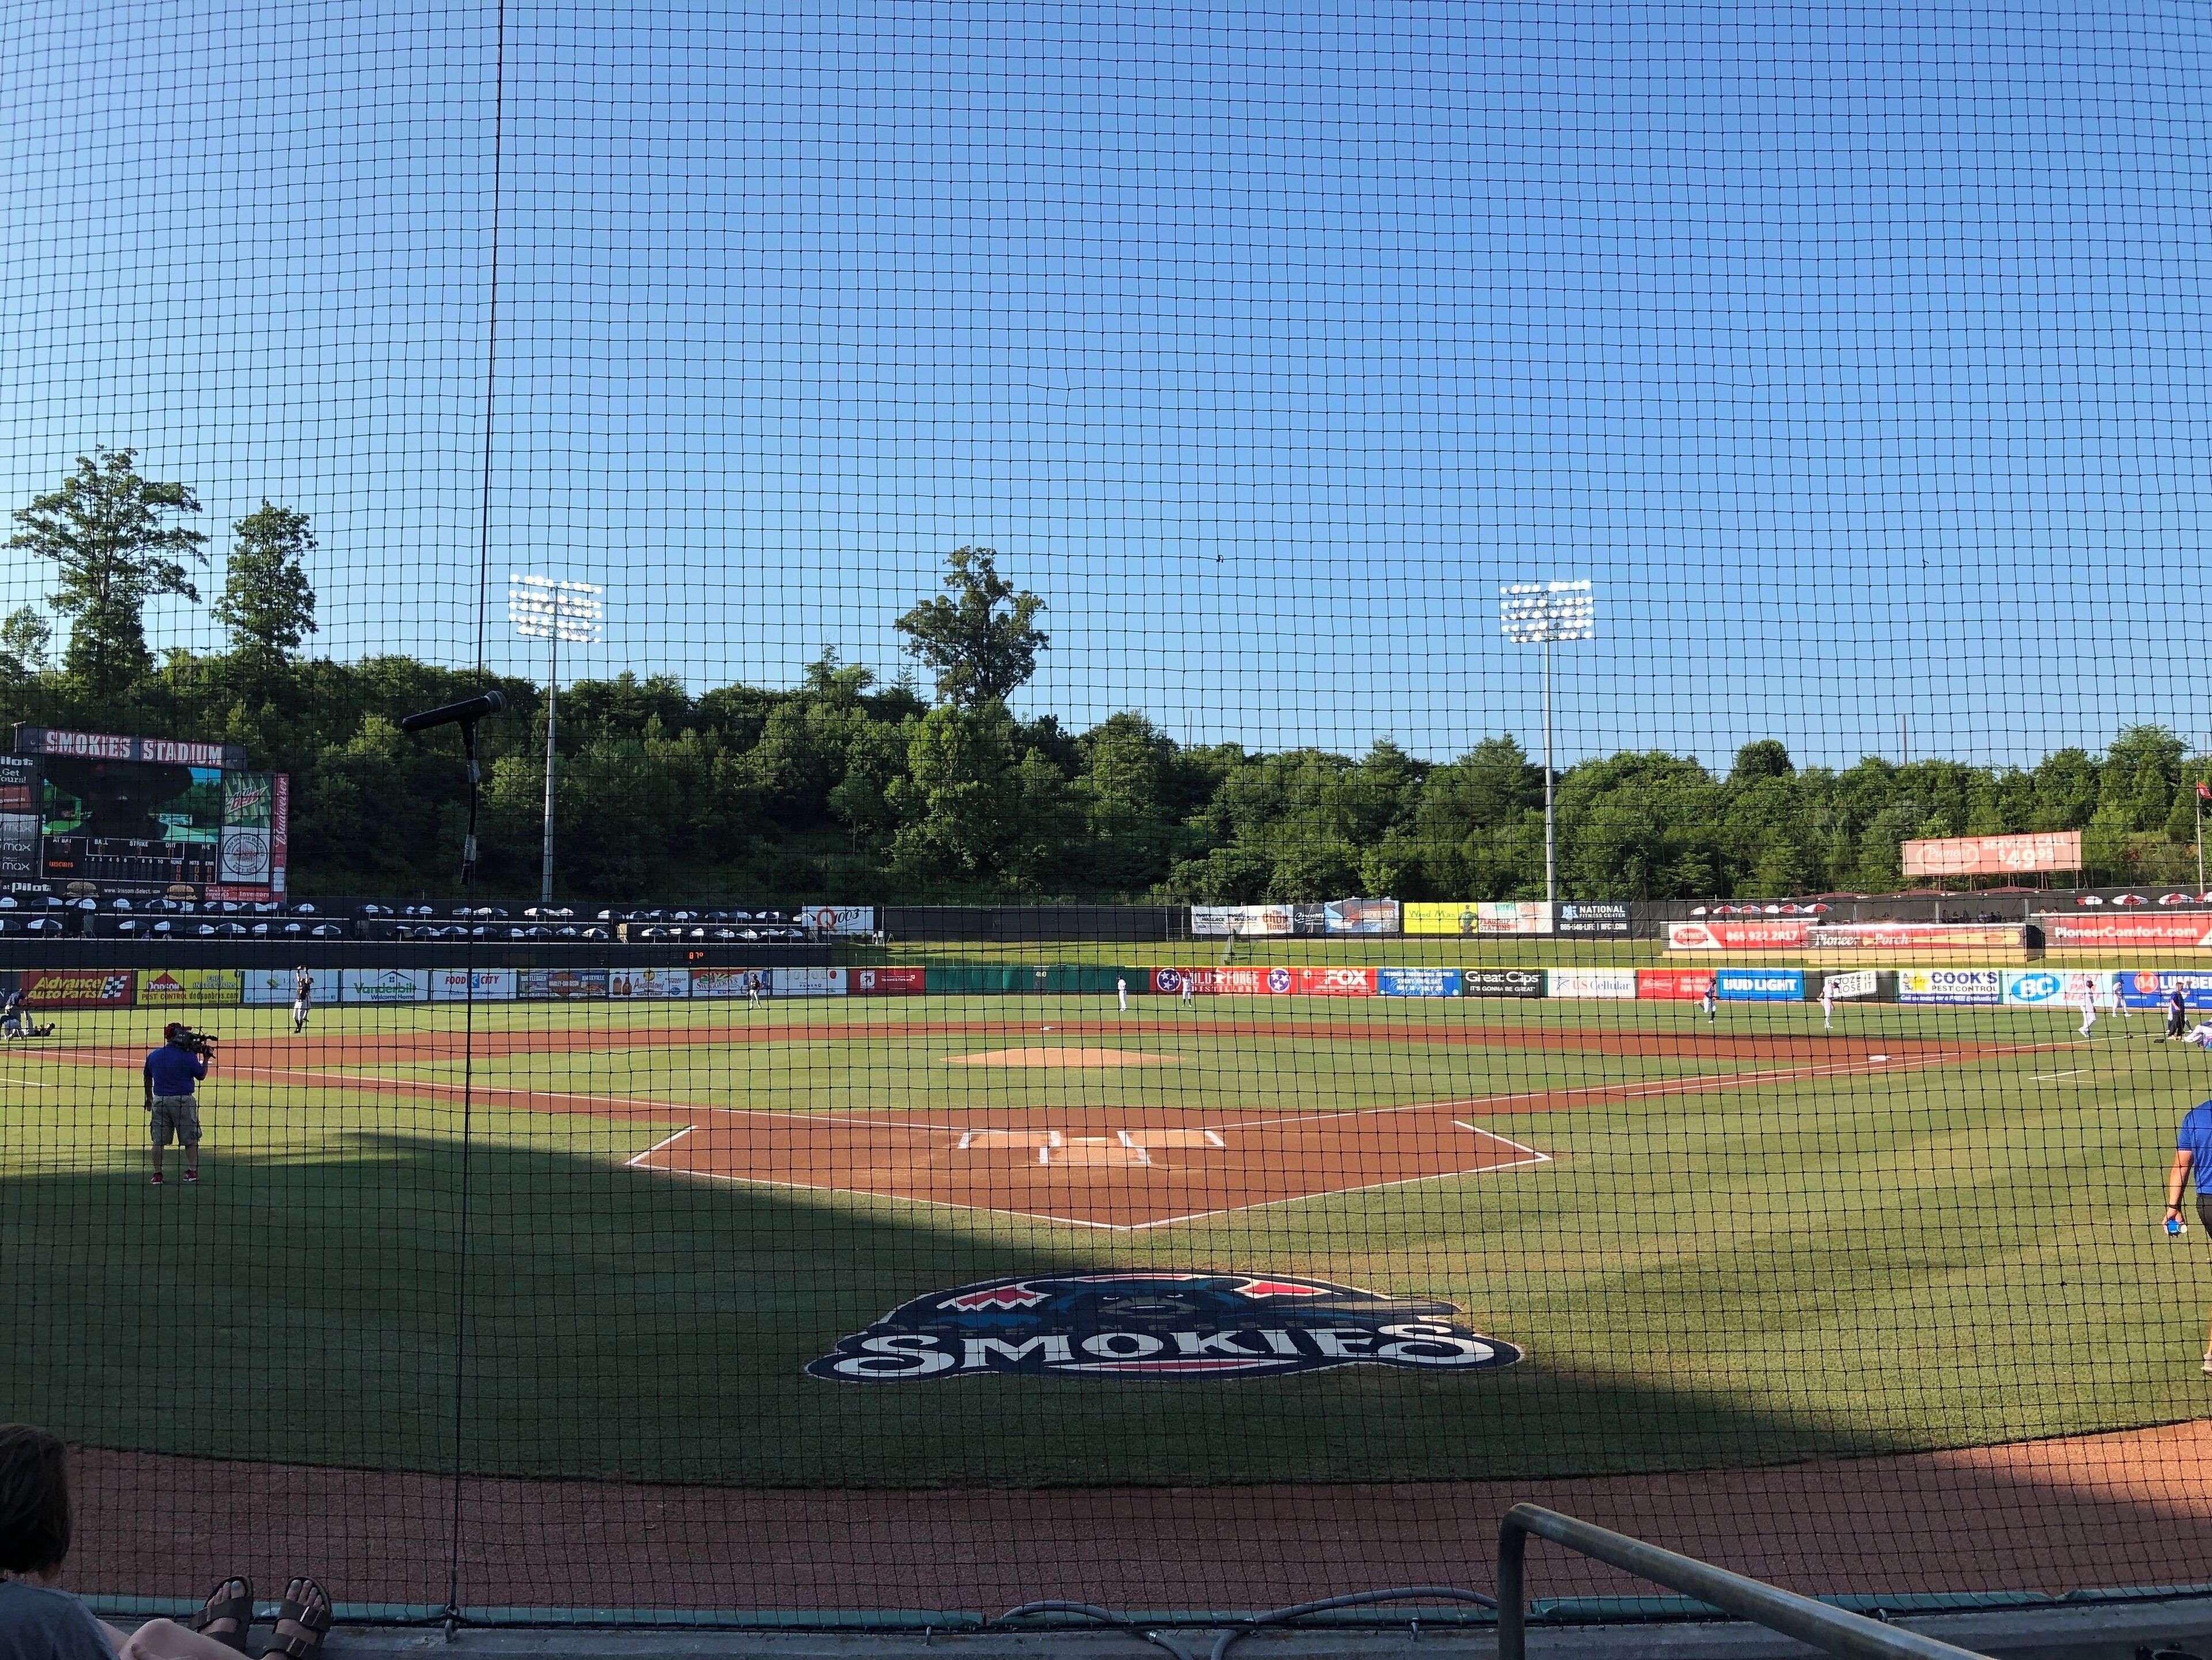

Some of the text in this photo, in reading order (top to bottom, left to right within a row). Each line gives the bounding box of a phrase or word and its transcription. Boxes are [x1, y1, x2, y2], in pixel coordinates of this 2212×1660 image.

[46, 731, 222, 766] SMOKIES STADIUM
[2, 768, 20, 777] Get
[0, 775, 26, 783] ours!
[274, 777, 287, 848] Budweiser
[3, 842, 32, 851] max
[1982, 836, 2068, 850] SERVICE CALL
[2, 862, 30, 871] max
[1579, 905, 1626, 913] NATIONAL
[1726, 930, 1798, 941] 865.922.2817
[2055, 926, 2198, 938] PioneerComfort.com
[1815, 933, 1909, 946] Pioneer Porch
[33, 976, 102, 989] Advance
[445, 975, 500, 985] FOOD CITY
[1226, 970, 1259, 984] FORGE
[1327, 969, 1369, 986] FOX
[1464, 970, 1540, 985] Great Clips
[1828, 975, 1861, 985] BOOZE
[1931, 971, 1998, 984] COOK'S
[2161, 975, 2212, 989] LUMBE
[354, 982, 416, 994] Vanderbilt
[1590, 980, 1631, 990] Cellular
[1723, 978, 1797, 992] BUD LIGHT
[1838, 982, 1872, 993] LOSE IT
[2020, 977, 2054, 999] BC
[28, 990, 97, 1000] Auto Parts
[832, 1323, 1495, 1378] SMOKIES
